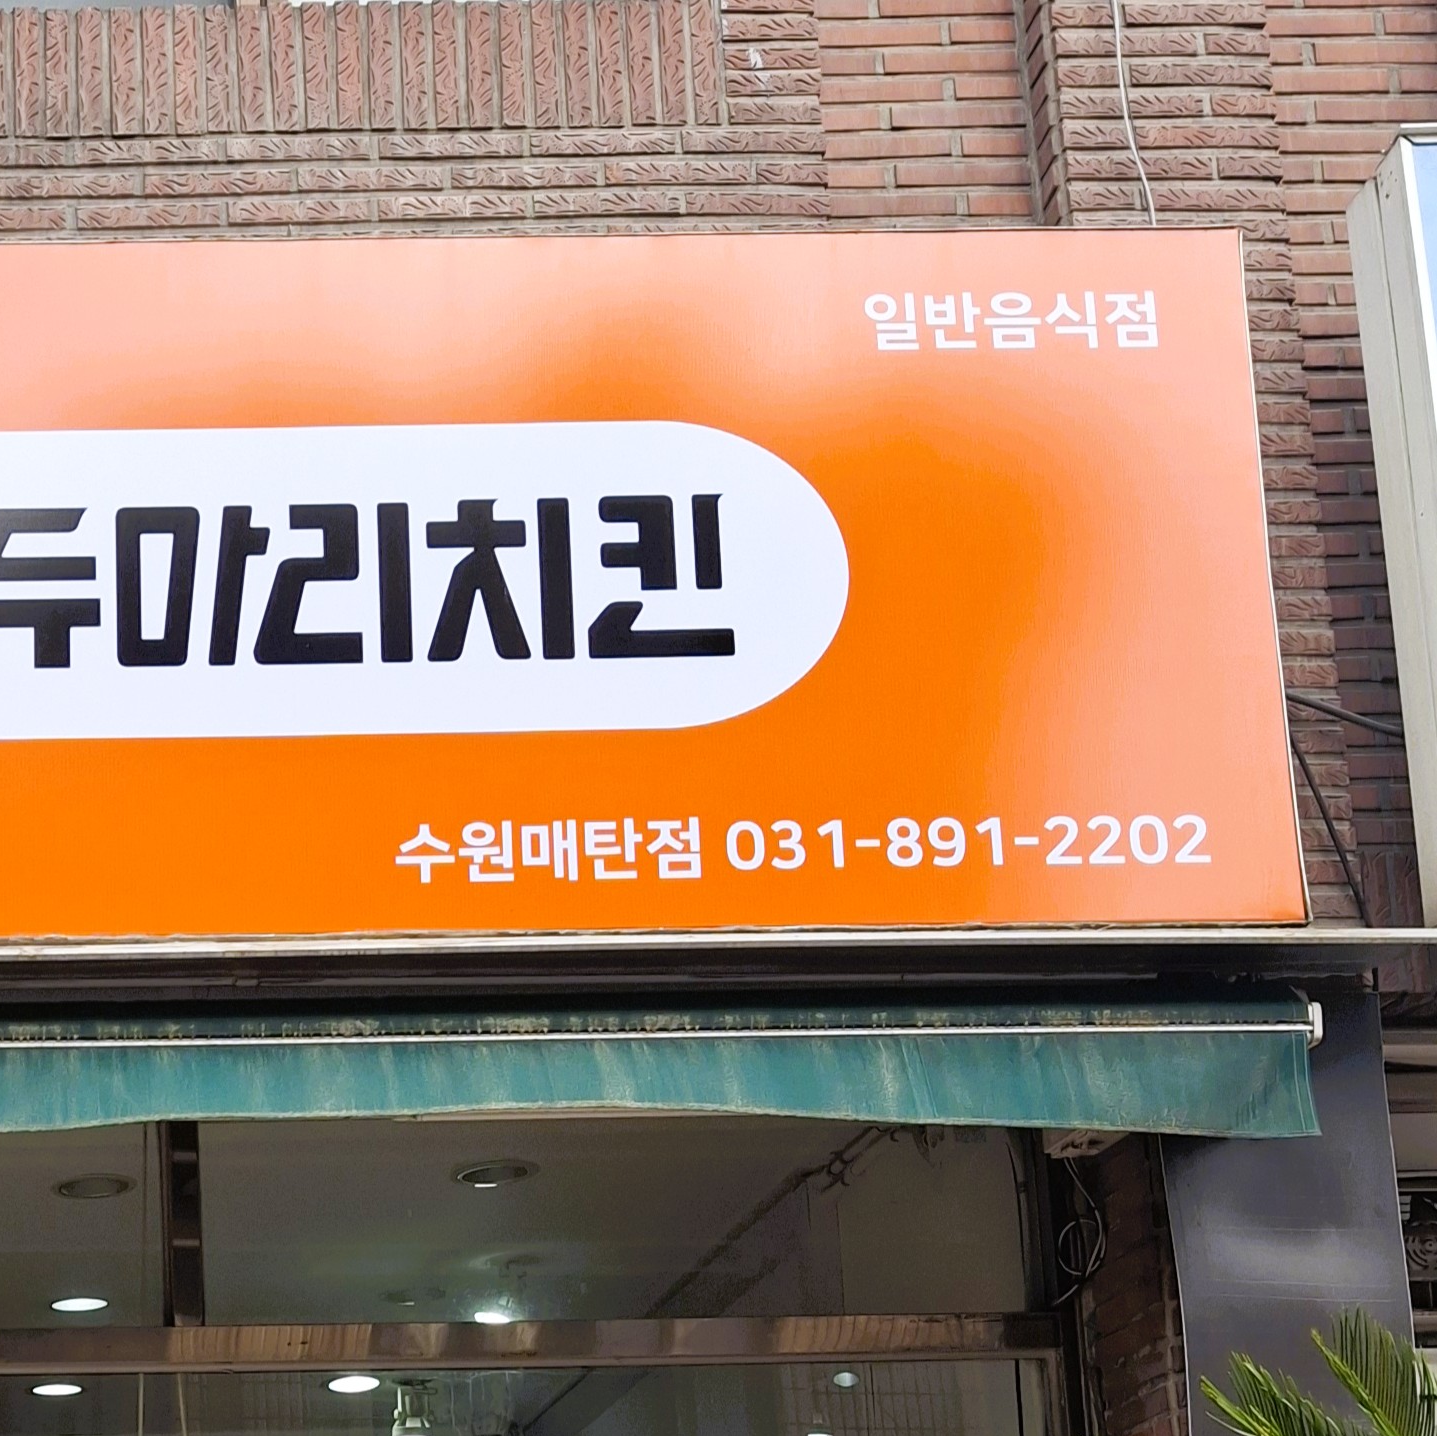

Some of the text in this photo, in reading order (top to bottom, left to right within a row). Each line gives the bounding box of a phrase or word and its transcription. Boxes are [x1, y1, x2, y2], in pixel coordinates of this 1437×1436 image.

[863, 290, 1159, 350] 일반음식점
[393, 813, 1214, 884] 수원매탄점 031-891-2202
